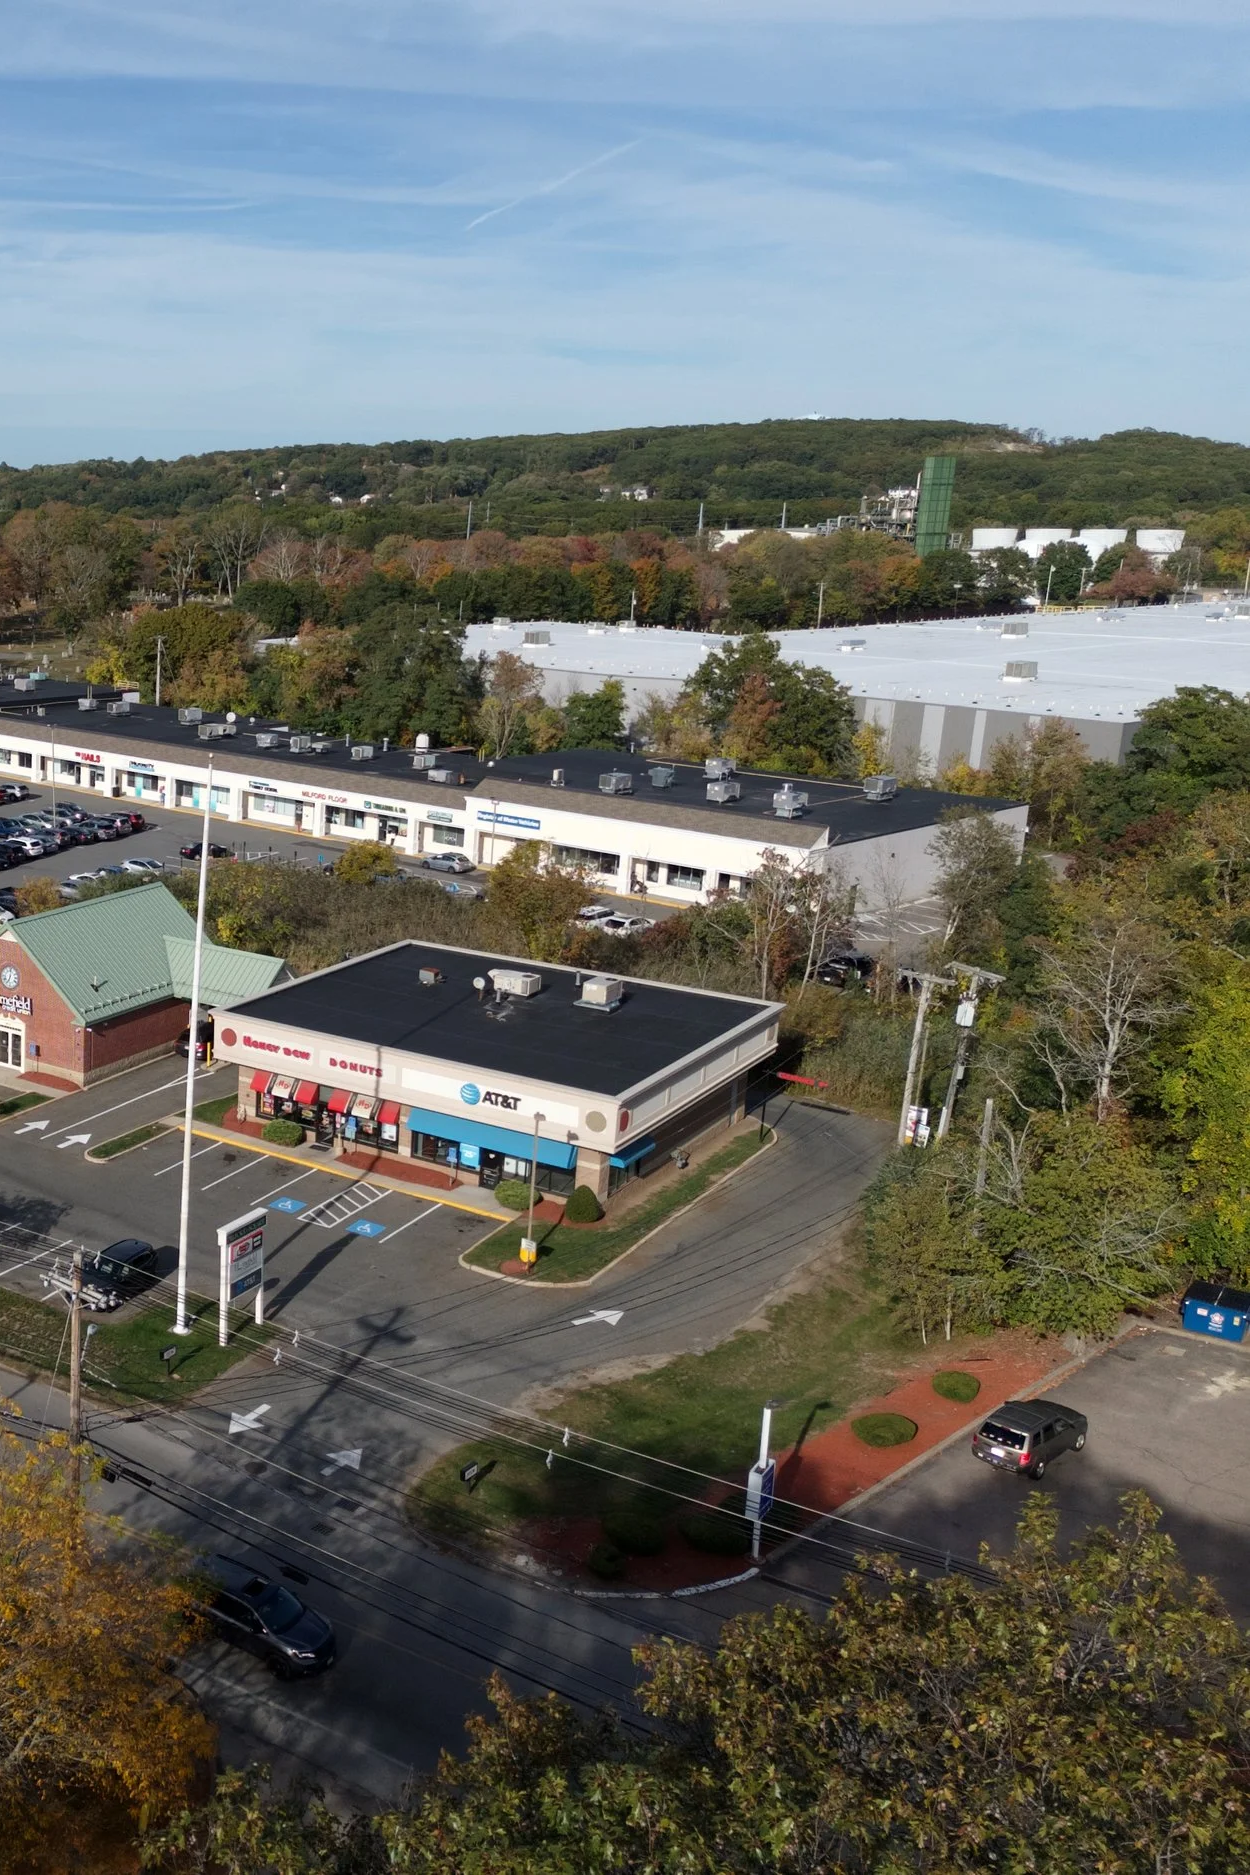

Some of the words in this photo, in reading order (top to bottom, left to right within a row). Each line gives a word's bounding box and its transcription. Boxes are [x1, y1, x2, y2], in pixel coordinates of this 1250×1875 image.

[301, 790, 326, 800] MILFORD
[328, 794, 348, 804] FLOOR
[329, 1057, 383, 1078] DONUTS
[482, 1090, 522, 1111] AT&T
